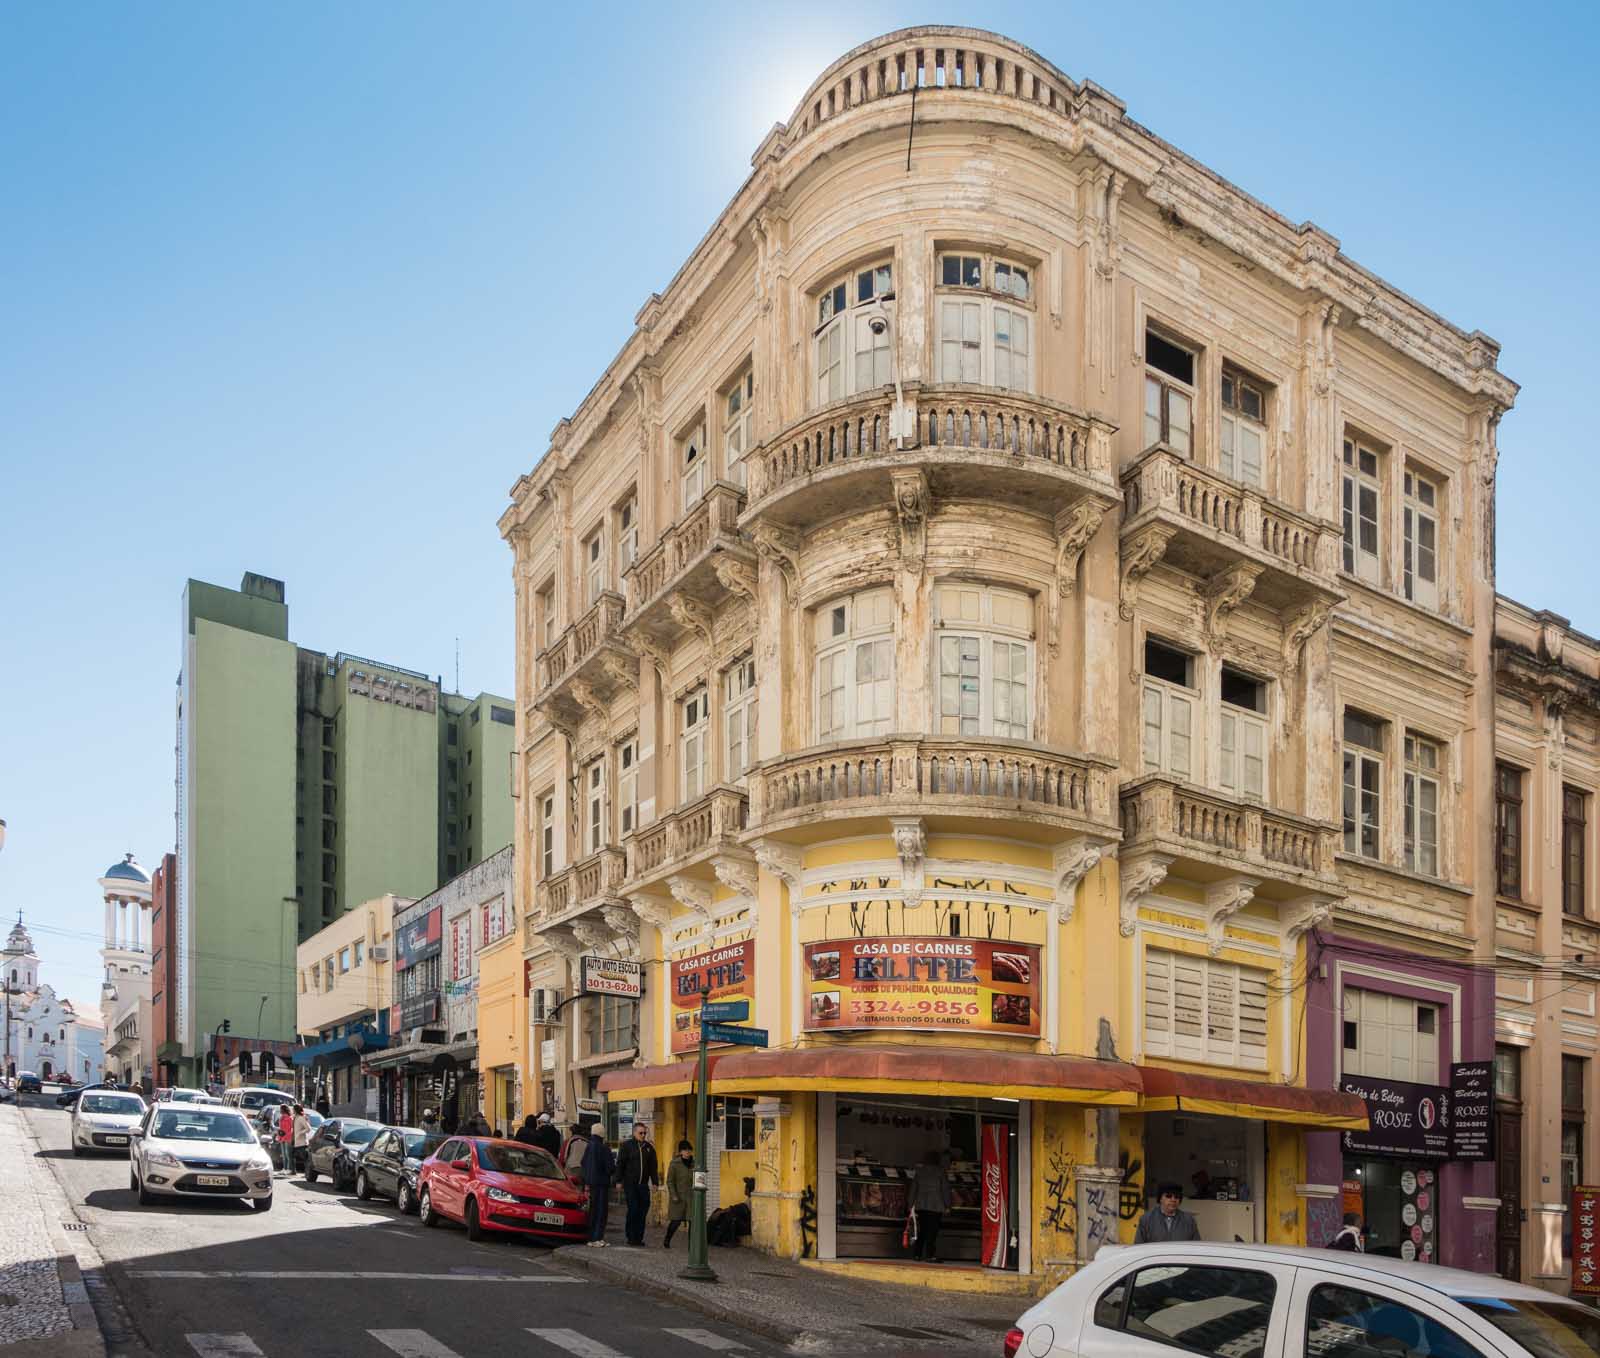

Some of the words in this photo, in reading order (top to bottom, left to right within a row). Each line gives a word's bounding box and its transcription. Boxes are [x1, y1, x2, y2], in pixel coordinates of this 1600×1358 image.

[854, 944, 888, 955] CASA
[892, 943, 911, 954] DE
[915, 943, 972, 956] CARNES
[679, 960, 699, 972] CASA
[700, 955, 712, 967] DE
[712, 946, 744, 963] CARNES
[586, 958, 601, 970] AUTO
[602, 960, 617, 972] MOTO
[618, 963, 639, 975] ESCOLA
[852, 956, 982, 984] ELITE
[587, 979, 639, 993] 3013-6280
[851, 984, 879, 993] CARNES
[880, 984, 891, 993] DE
[892, 984, 930, 994] PRIMEIRA
[931, 985, 979, 996] QUALIDADE
[850, 1000, 980, 1015] 3324-9856
[855, 1015, 895, 1023] ACEITAMOS
[924, 1016, 935, 1024] OS
[936, 1016, 971, 1025] CARTÕES
[1466, 1079, 1480, 1087] de
[1369, 1089, 1379, 1101] de
[1455, 1105, 1489, 1117] ROSE
[1374, 1109, 1413, 1129] ROSE
[985, 1159, 1001, 1223] Coca-Cola
